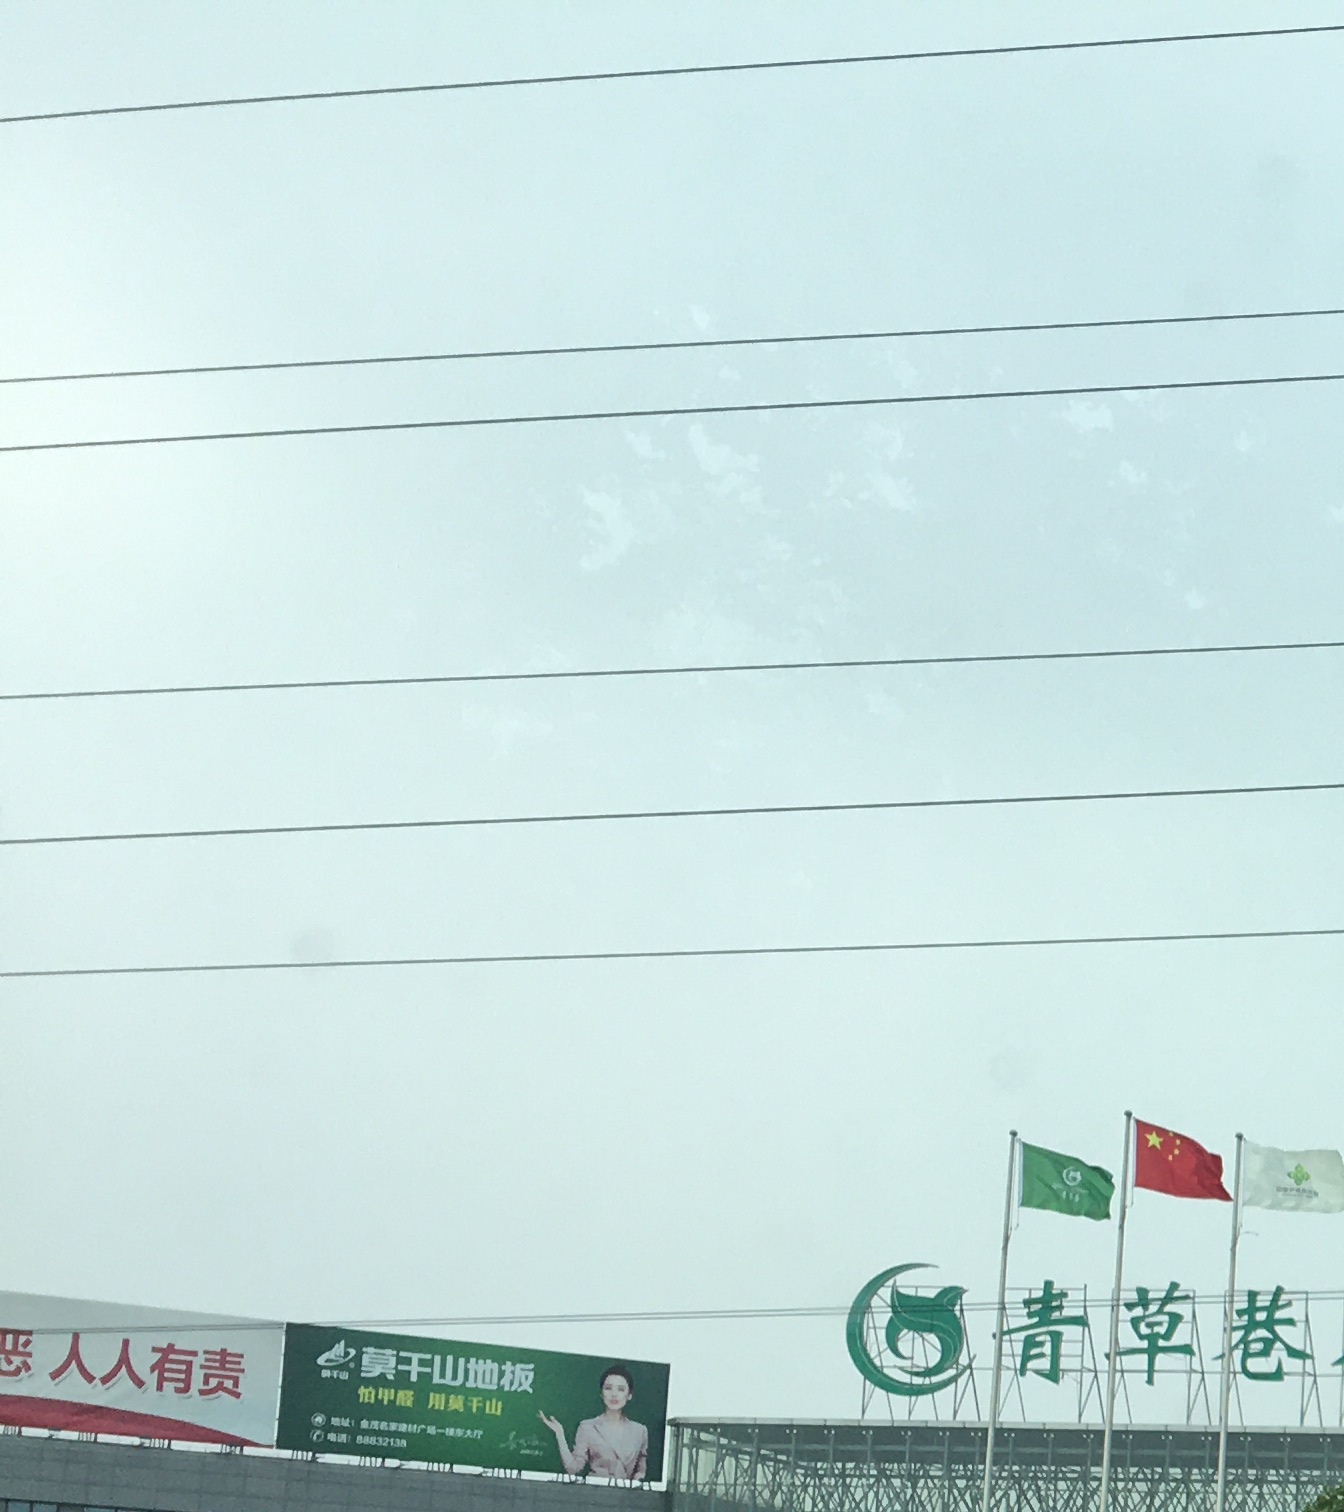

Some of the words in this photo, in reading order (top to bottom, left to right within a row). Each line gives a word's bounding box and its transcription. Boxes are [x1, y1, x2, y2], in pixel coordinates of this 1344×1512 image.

[49, 1332, 245, 1399] 人人有责
[361, 1347, 535, 1393] 莫干山地板
[358, 1385, 414, 1408] 怕甲醛
[428, 1392, 502, 1416] 用莫干山
